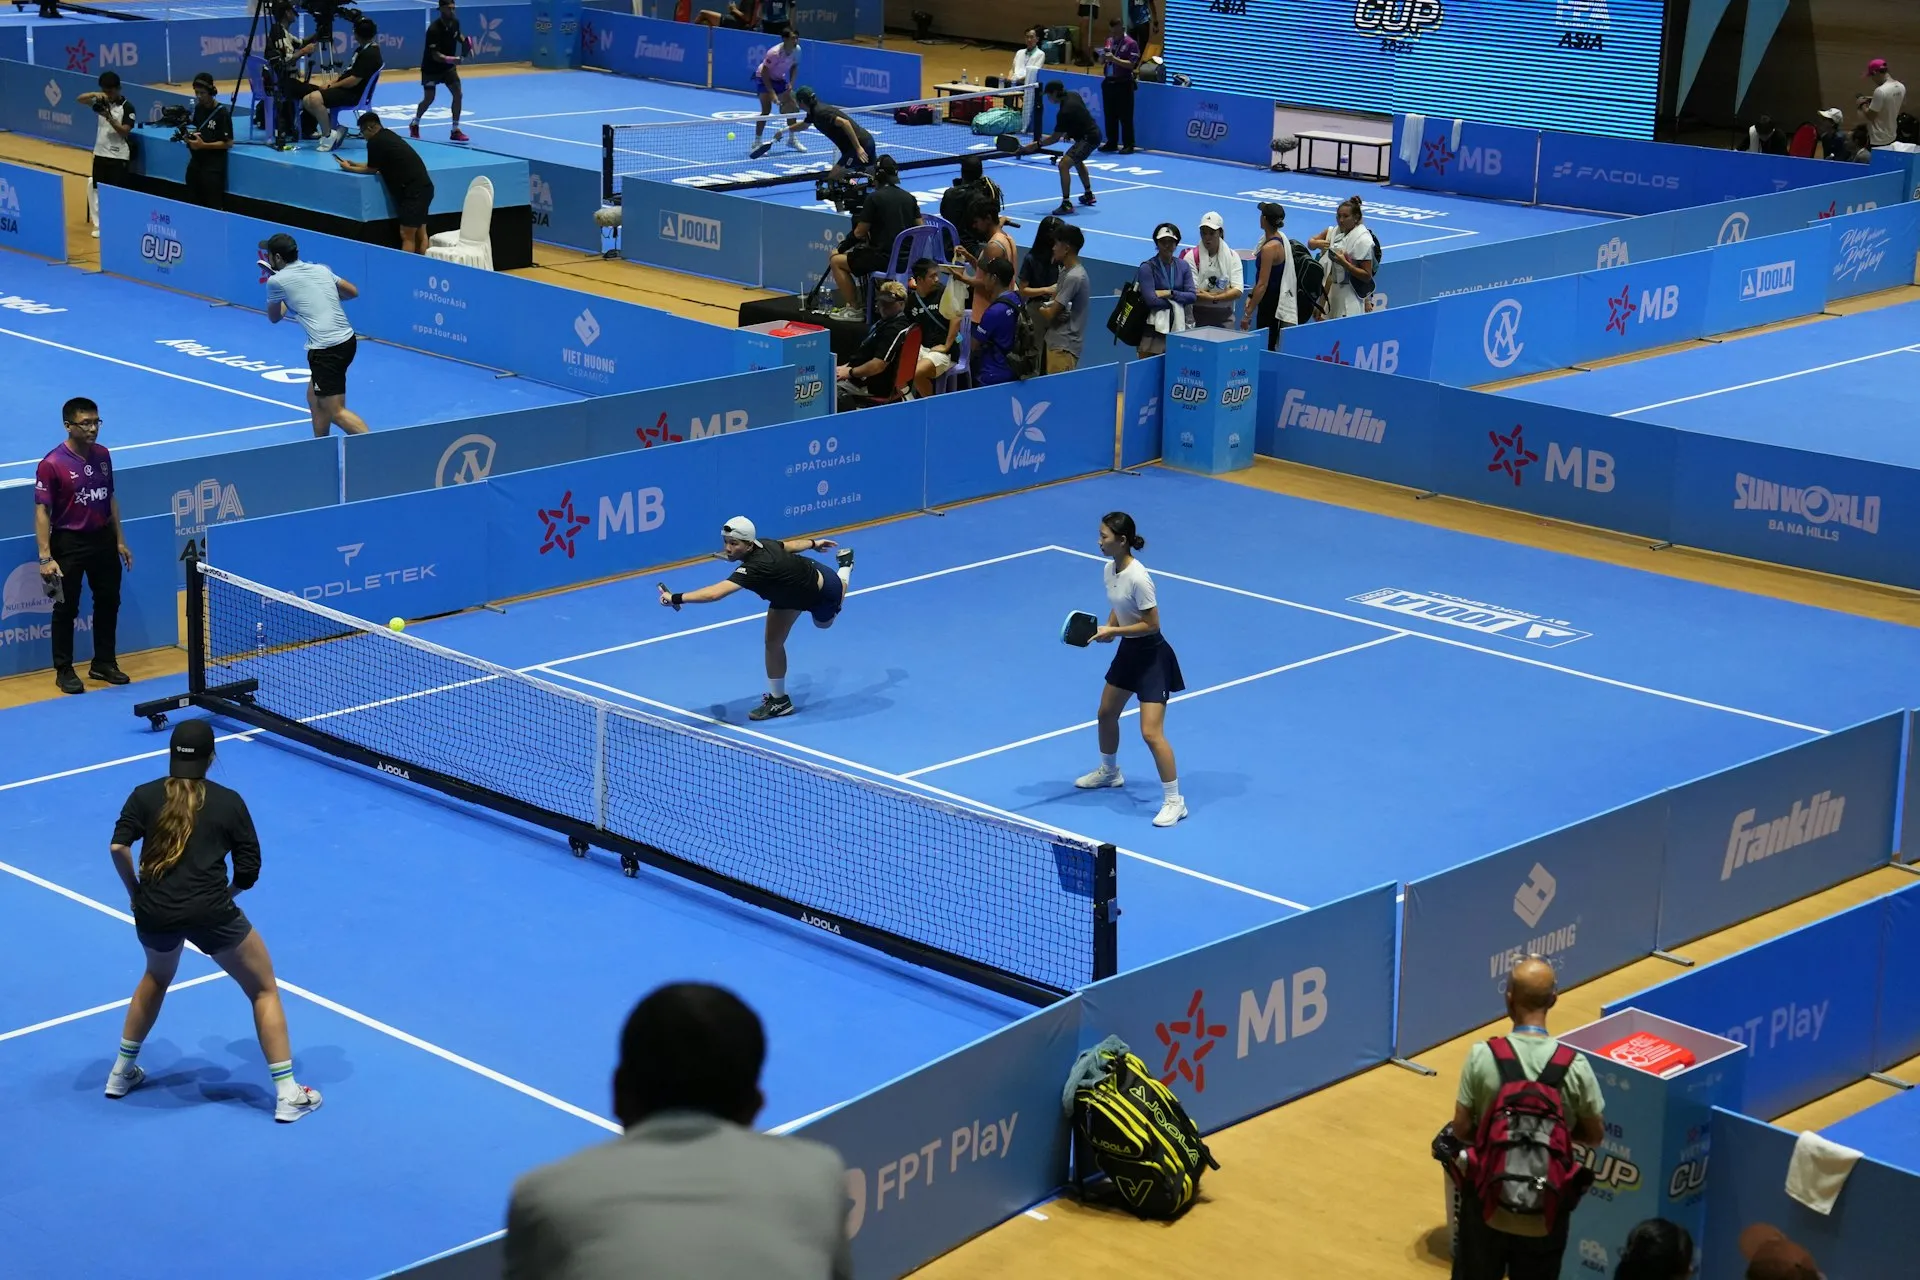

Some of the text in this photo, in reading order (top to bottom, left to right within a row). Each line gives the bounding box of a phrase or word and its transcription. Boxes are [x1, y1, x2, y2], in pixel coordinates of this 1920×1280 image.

[1354, 0, 1444, 40] CUP
[100, 42, 138, 67] MB
[1558, 32, 1602, 50] ASIA
[858, 69, 889, 92] JOOLA
[1186, 119, 1228, 140] CUP
[1458, 145, 1502, 175] MB
[1576, 167, 1680, 189] FACOLOS
[0, 216, 18, 234] SIA
[530, 209, 550, 228] SIA
[680, 219, 719, 246] JOOLA
[141, 233, 183, 264] CUP
[1758, 266, 1793, 292] JOOLA
[1639, 285, 1679, 323] MB
[562, 347, 615, 374] VIET HUONG
[1354, 340, 1399, 374] MB
[1171, 384, 1208, 403] CUP
[1221, 385, 1251, 405] CUP
[690, 410, 749, 440] MB
[1276, 388, 1387, 444] Franklin
[785, 452, 861, 478] @PPATourAsia
[1545, 442, 1616, 492] MB
[90, 487, 108, 501] MB
[172, 478, 245, 528] PPA
[784, 492, 862, 518] @ppa.tour.asia
[598, 487, 666, 540] MB
[1768, 519, 1840, 542] BA NA HILLS
[1380, 593, 1523, 632] JOOLA
[384, 764, 410, 779] JOOLA
[1721, 790, 1846, 881] Franklin
[808, 916, 841, 934] JOOLA
[1490, 945, 1522, 978] VIET
[1527, 924, 1577, 959] HUONG
[1237, 966, 1328, 1059] MB
[1769, 999, 1829, 1049] Play
[1100, 1140, 1132, 1154] JOOLA
[1144, 1101, 1201, 1168] JOOLA
[877, 1112, 1019, 1212] FPT Play
[1668, 1156, 1710, 1198] CU
